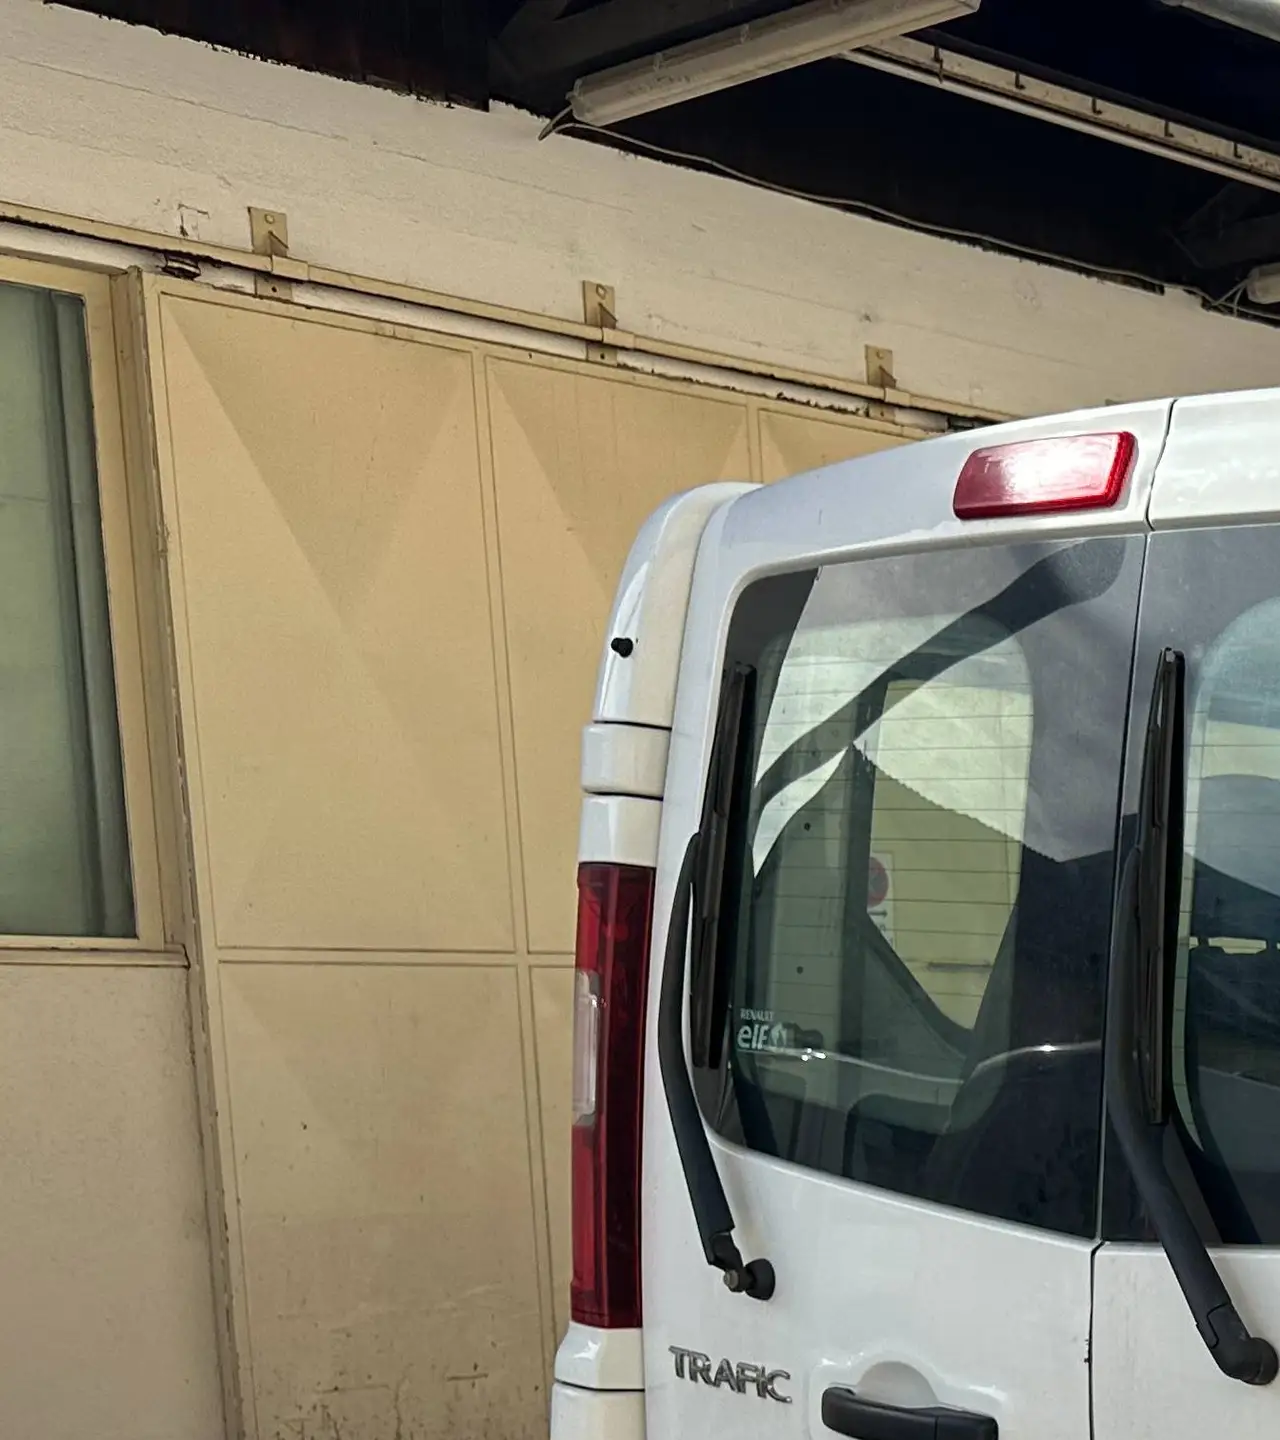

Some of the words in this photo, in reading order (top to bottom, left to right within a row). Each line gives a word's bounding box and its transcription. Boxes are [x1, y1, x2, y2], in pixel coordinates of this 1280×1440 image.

[740, 1008, 775, 1021] RENAULT
[737, 1024, 769, 1050] elf
[668, 1345, 793, 1404] TRAFIC
